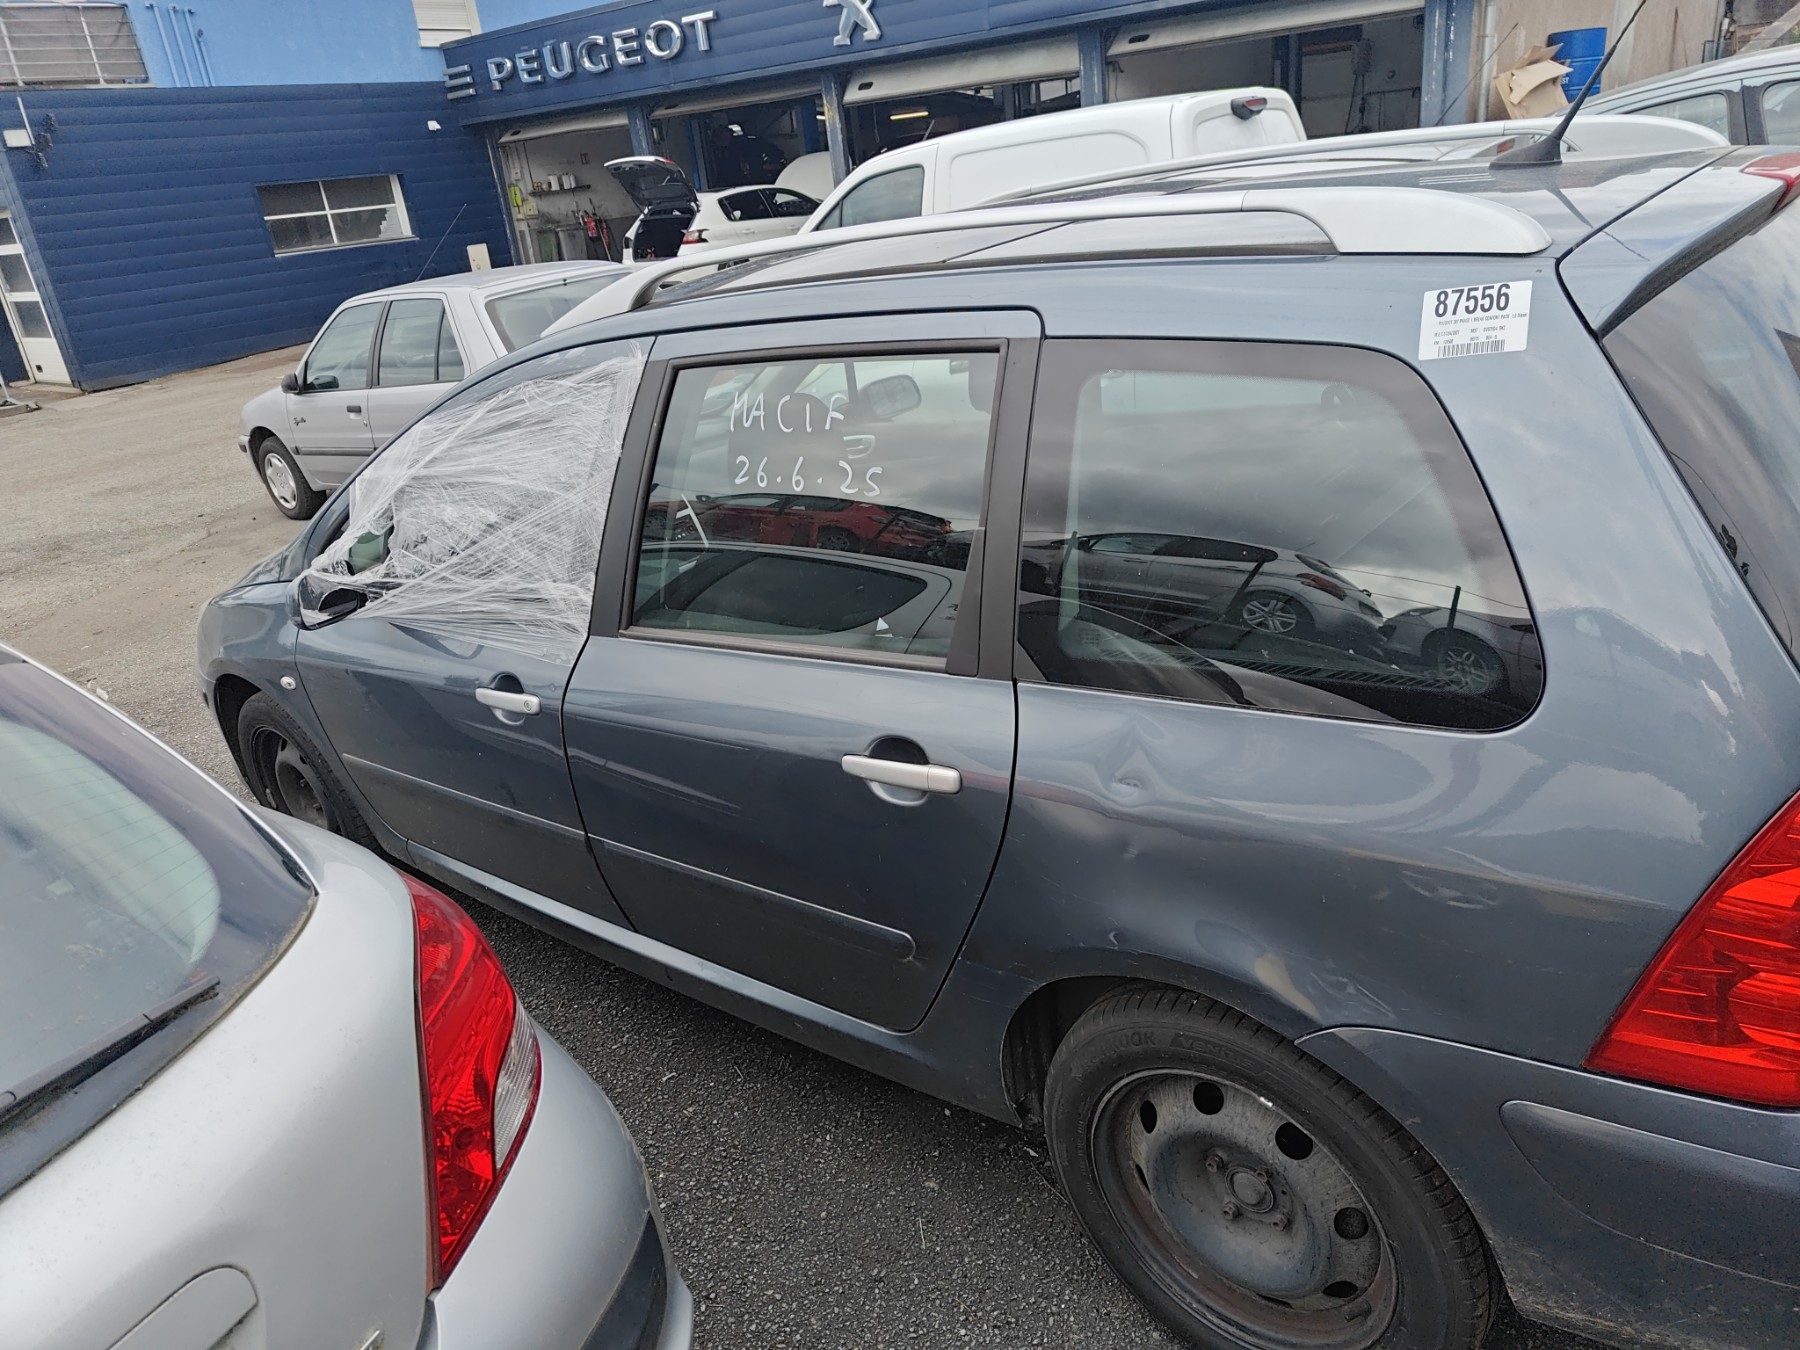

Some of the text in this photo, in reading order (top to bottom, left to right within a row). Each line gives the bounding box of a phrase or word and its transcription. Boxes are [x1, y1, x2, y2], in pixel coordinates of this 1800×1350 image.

[487, 10, 717, 91] PEUGEOT
[1434, 283, 1511, 318] 87556
[729, 391, 848, 433] MACIF
